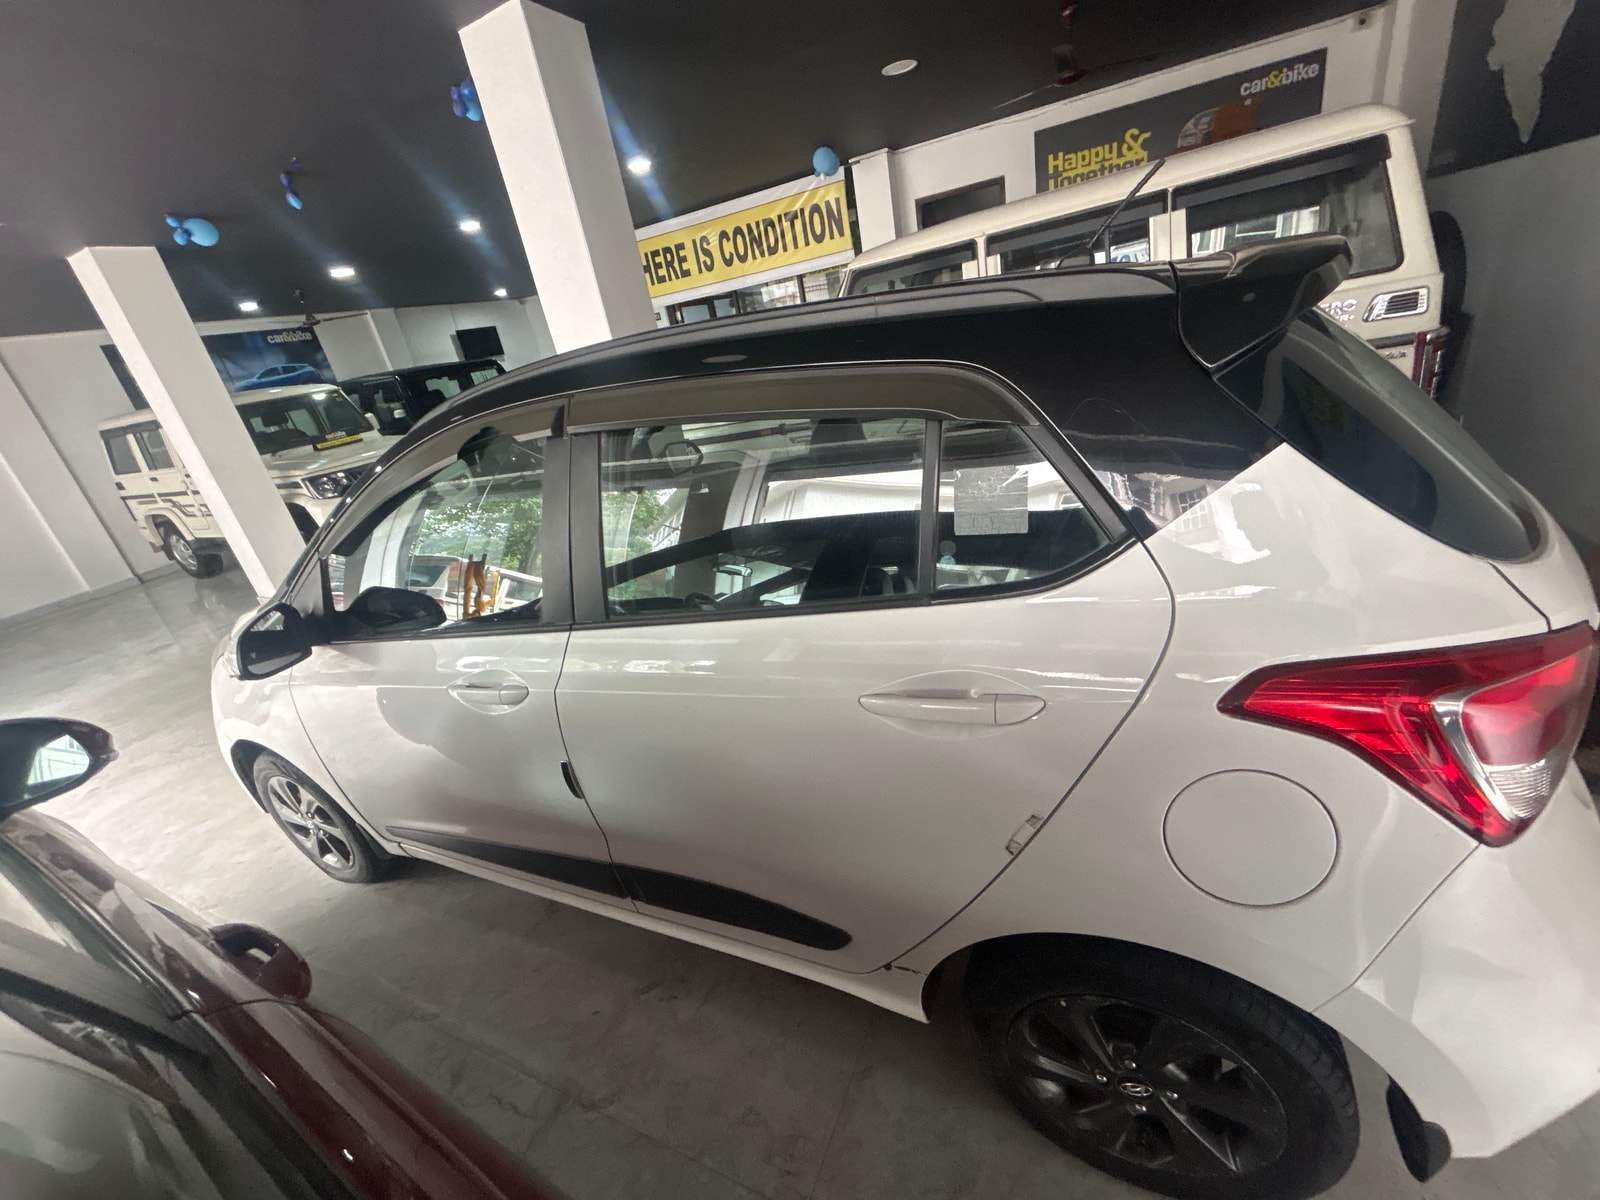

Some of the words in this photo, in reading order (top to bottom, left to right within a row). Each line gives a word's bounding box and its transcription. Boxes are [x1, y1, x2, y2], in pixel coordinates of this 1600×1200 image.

[1240, 63, 1320, 96] car&bike
[1048, 141, 1118, 175] Happy
[1121, 127, 1152, 158] &
[692, 234, 715, 275] IS
[718, 196, 845, 268] CONDITION
[267, 330, 313, 344] car&bike
